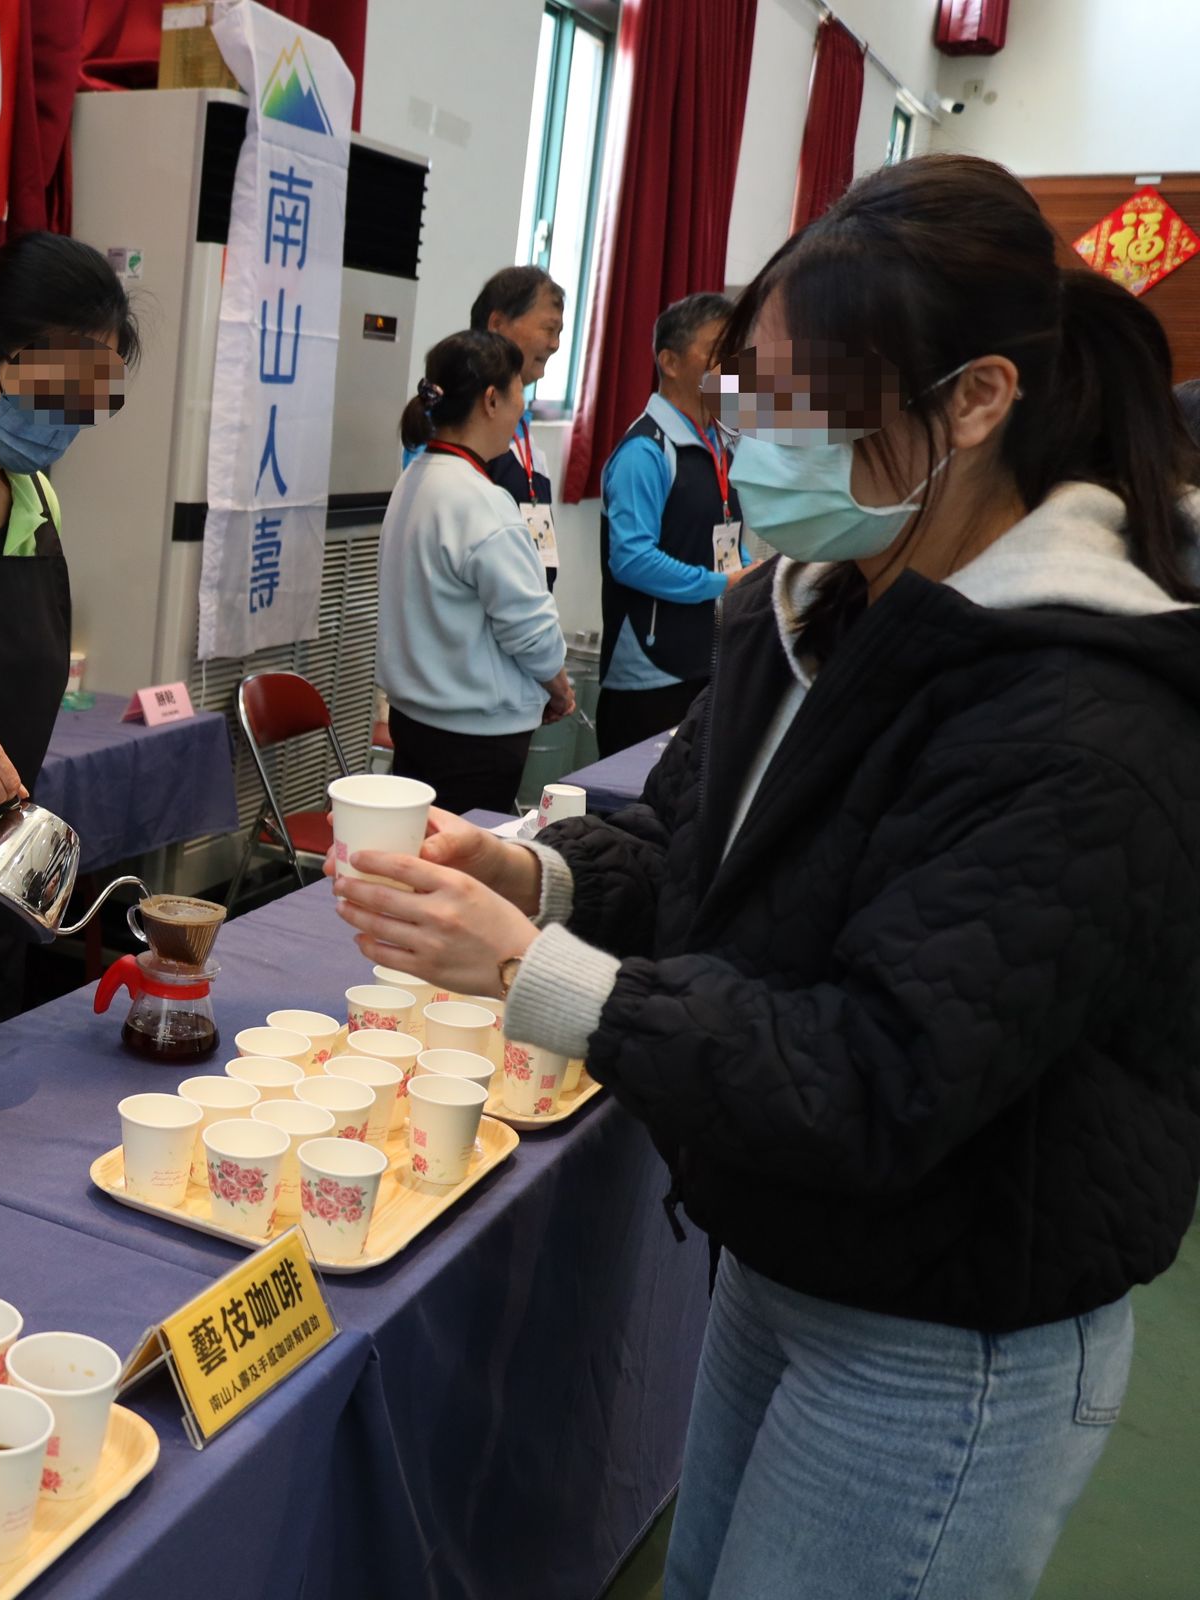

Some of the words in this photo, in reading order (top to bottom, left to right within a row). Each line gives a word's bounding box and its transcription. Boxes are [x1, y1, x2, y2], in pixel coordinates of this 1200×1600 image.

[1109, 211, 1165, 263] 福
[188, 1257, 304, 1377] 藝伎咖啡
